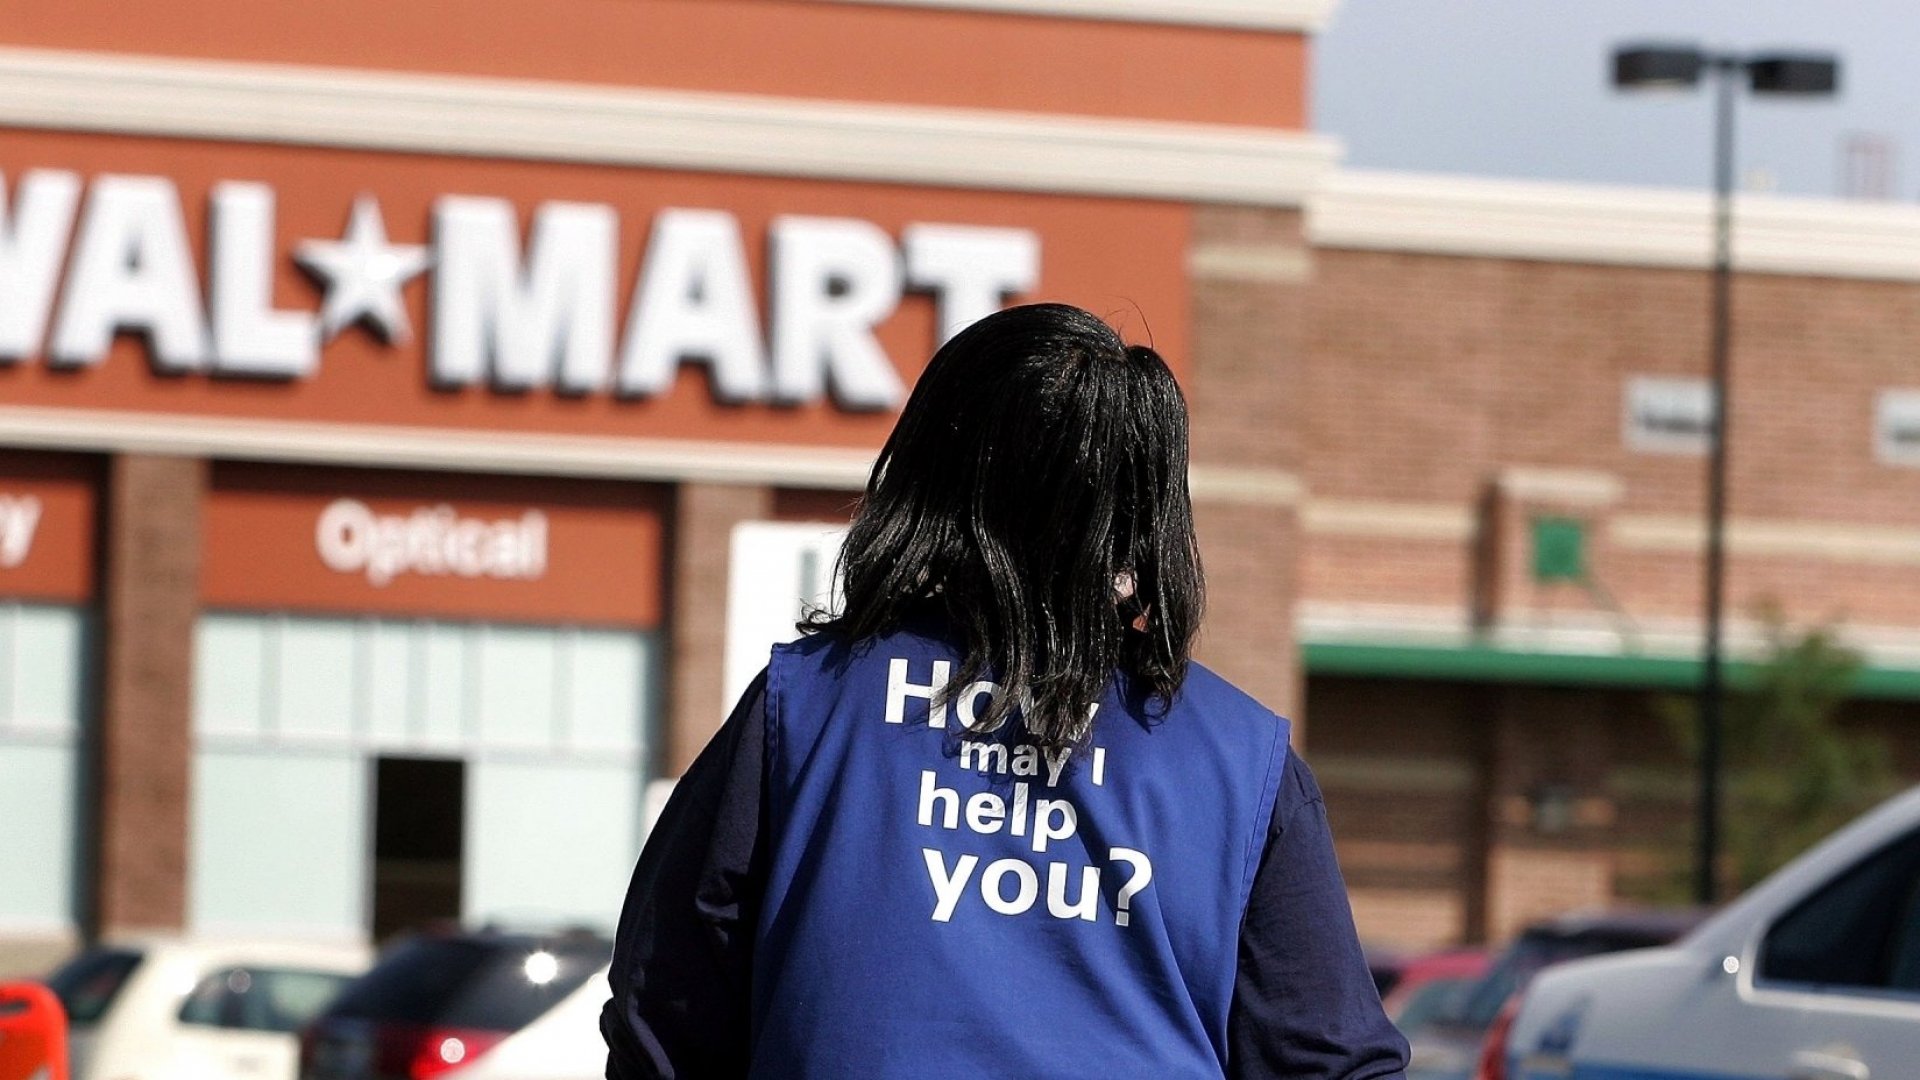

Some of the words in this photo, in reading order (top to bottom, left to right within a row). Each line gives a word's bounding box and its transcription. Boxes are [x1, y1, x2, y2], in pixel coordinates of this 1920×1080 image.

[316, 499, 548, 587] Optical
[960, 740, 1072, 787] may
[918, 770, 1078, 852] help
[922, 847, 1153, 927] you?
